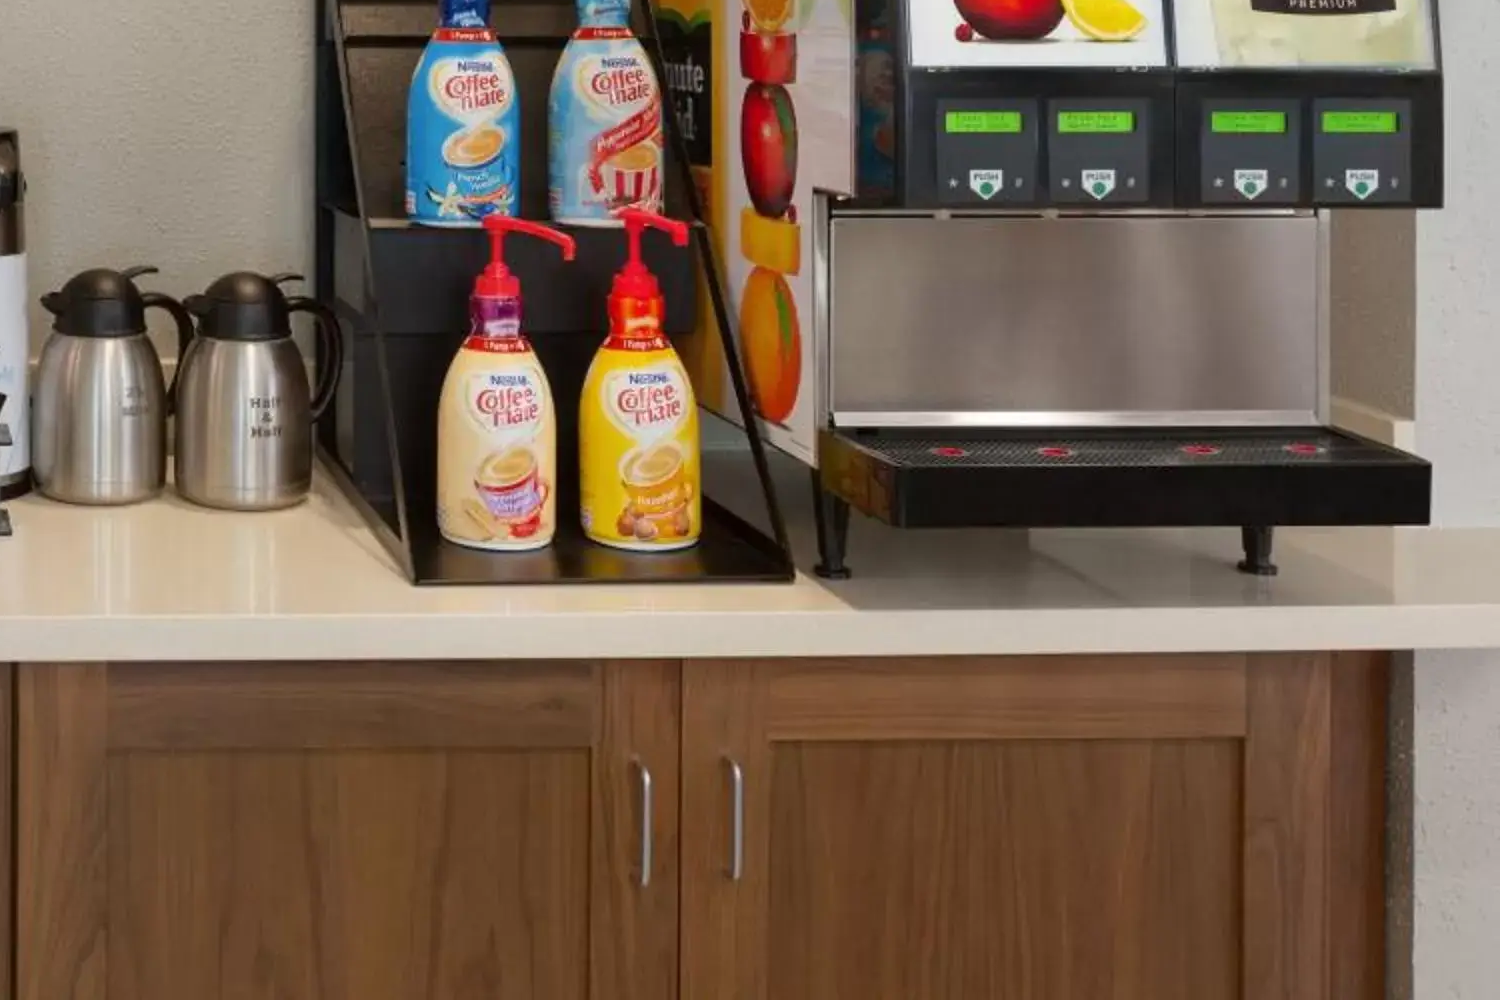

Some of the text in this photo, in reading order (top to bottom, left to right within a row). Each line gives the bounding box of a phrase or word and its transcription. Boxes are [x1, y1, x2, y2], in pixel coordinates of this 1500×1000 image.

[460, 87, 505, 111] mate
[609, 83, 651, 106] mate
[250, 398, 281, 409] Half
[635, 401, 681, 426] mate
[261, 412, 272, 422] &
[493, 404, 539, 427] mate
[250, 427, 282, 438] Half
